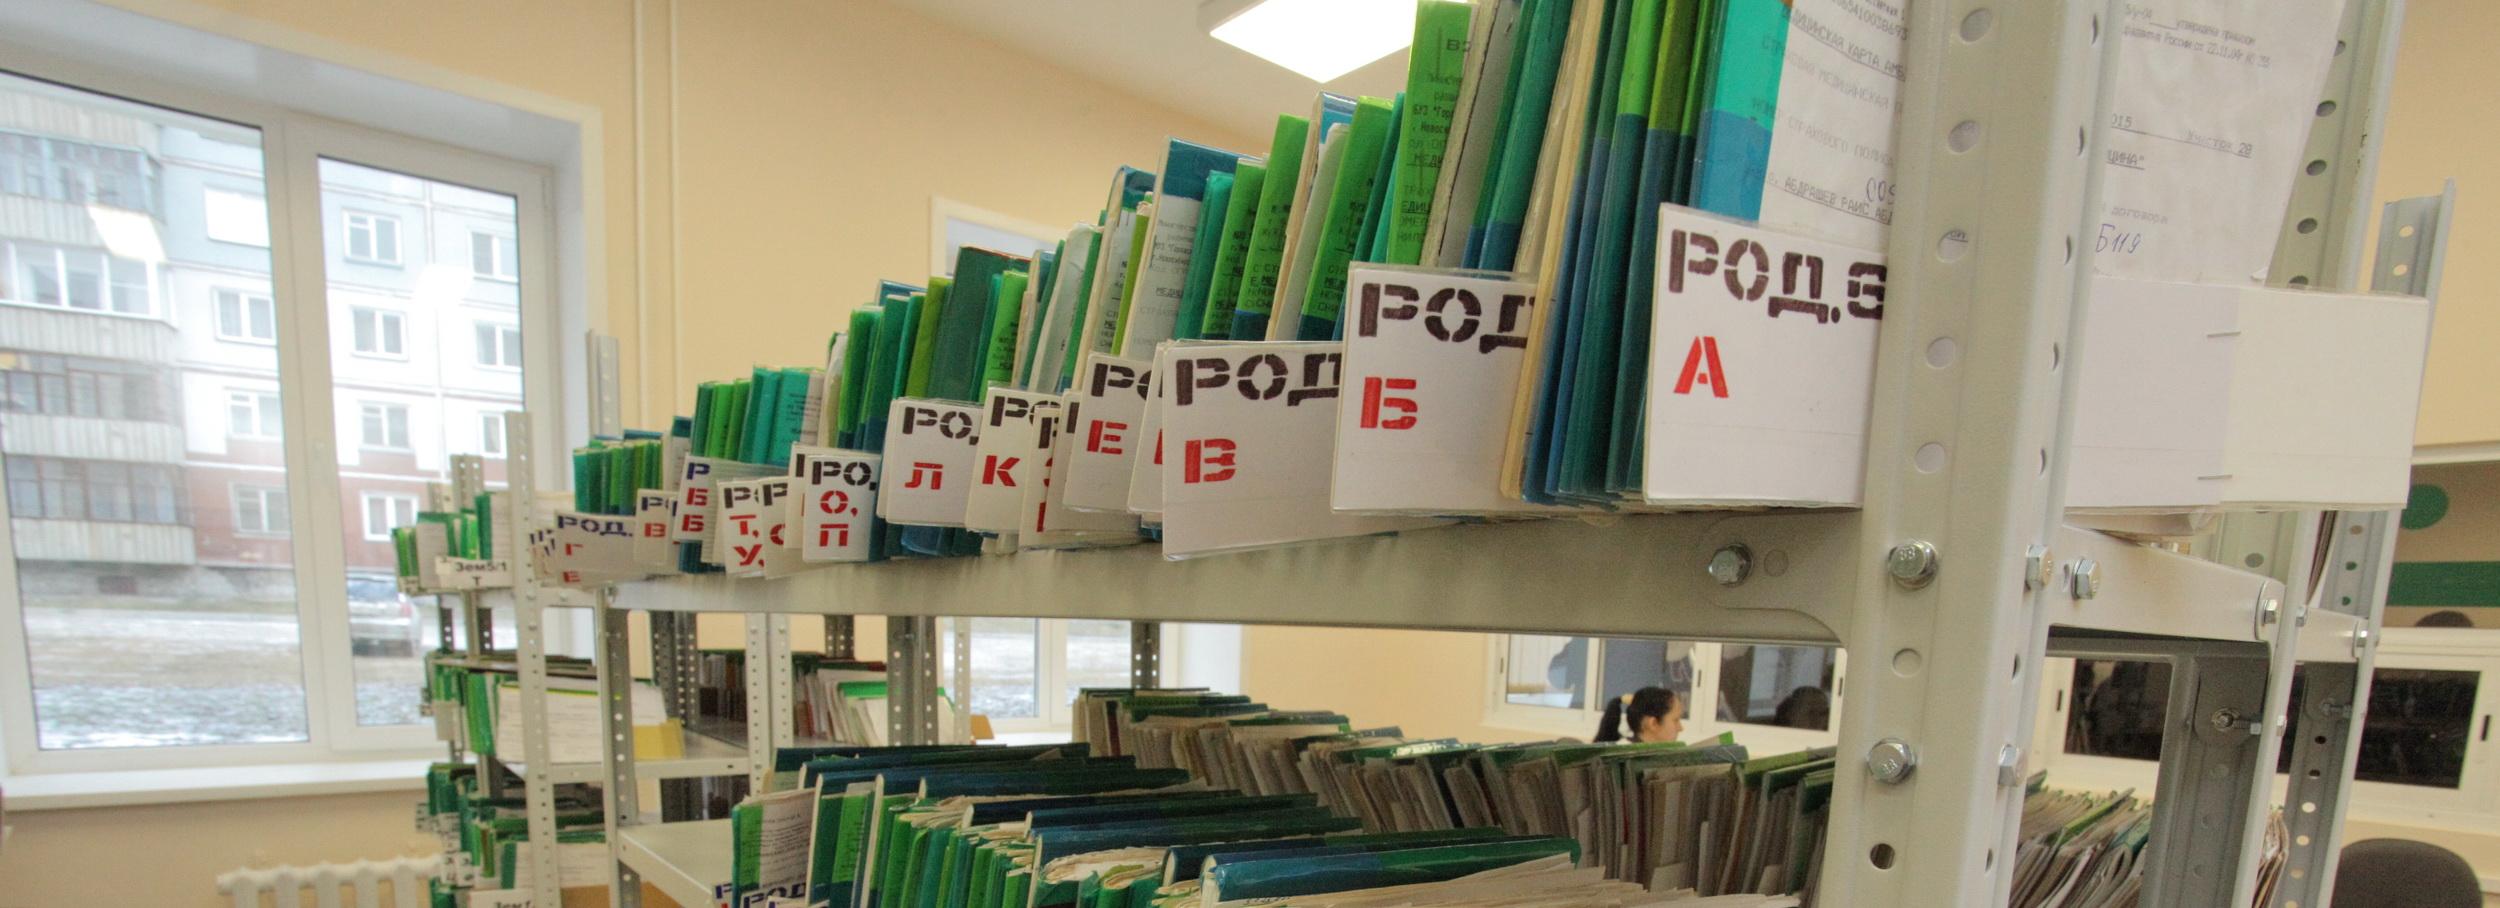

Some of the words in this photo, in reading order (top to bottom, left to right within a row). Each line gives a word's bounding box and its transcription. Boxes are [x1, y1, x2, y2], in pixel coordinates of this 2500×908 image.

[1176, 353, 1342, 406] РОД
[1673, 336, 1729, 398] А
[1360, 376, 1418, 430] Б
[903, 407, 979, 446] РО
[1086, 419, 1128, 455] Е
[812, 461, 877, 491] РО
[904, 462, 944, 490] Л
[982, 455, 1020, 487] К
[1184, 438, 1237, 484] В
[820, 524, 848, 547] П
